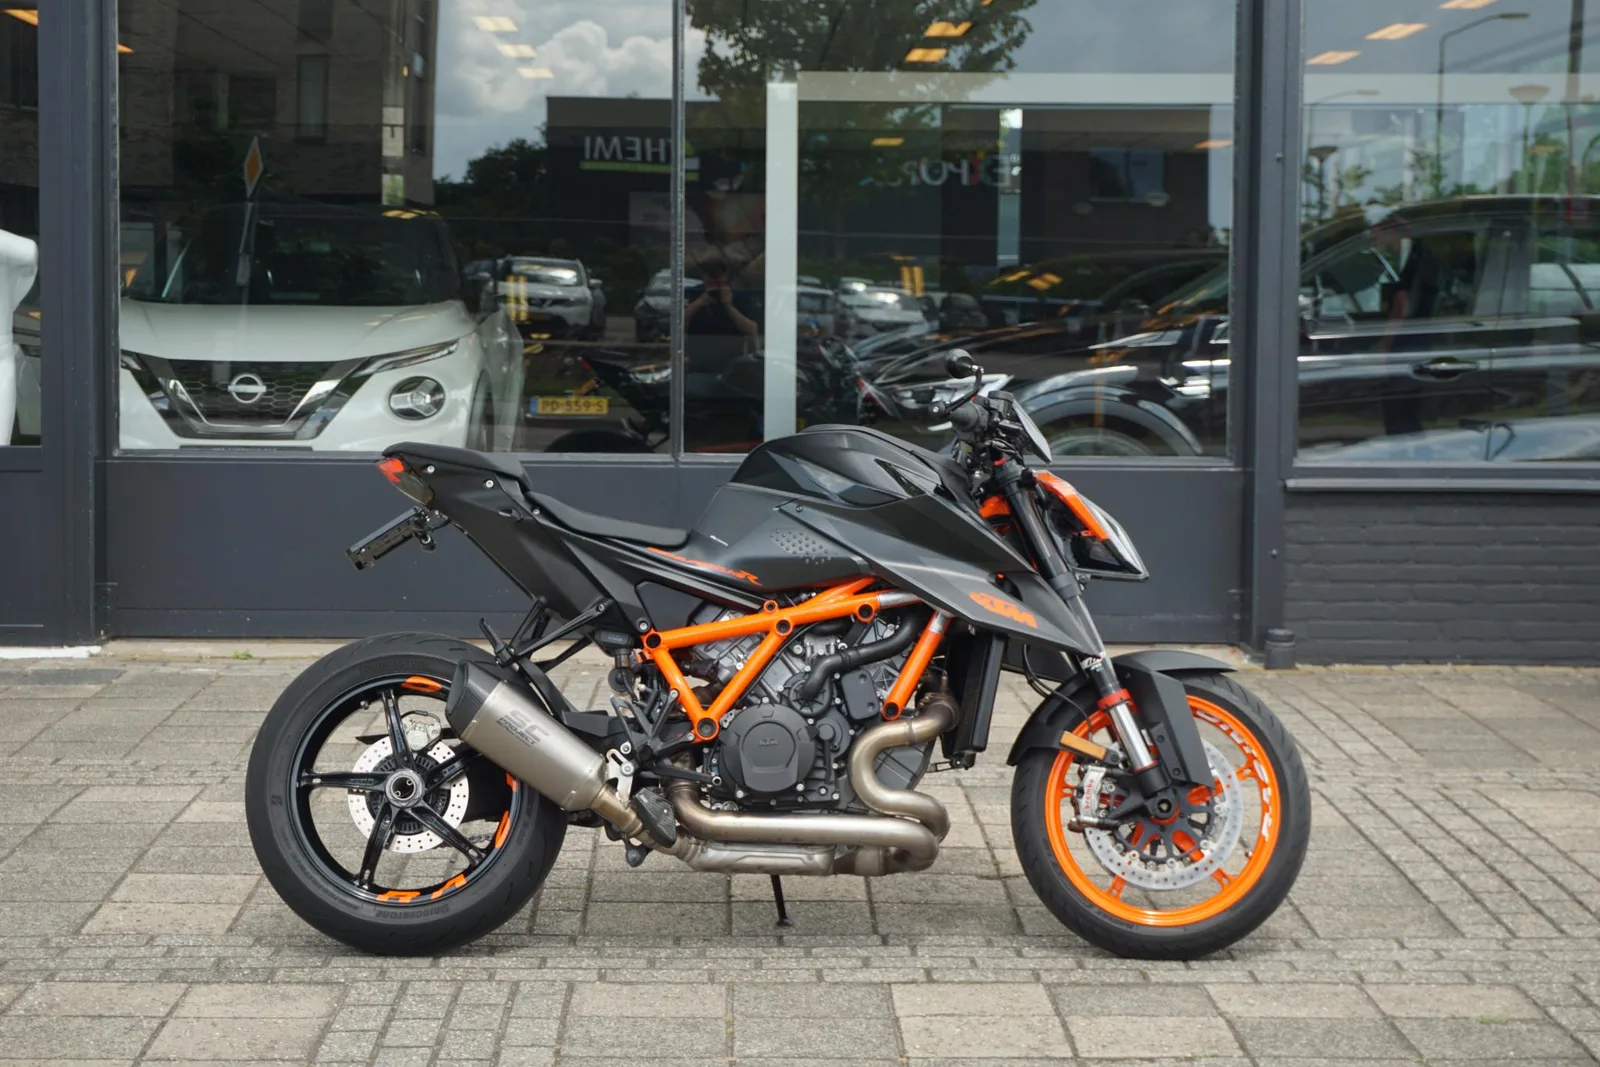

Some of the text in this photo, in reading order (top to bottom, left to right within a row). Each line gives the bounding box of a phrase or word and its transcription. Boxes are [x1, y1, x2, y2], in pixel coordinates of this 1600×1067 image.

[968, 592, 1038, 629] KTM
[499, 717, 538, 746] PROJECT
[504, 709, 551, 743] SC
